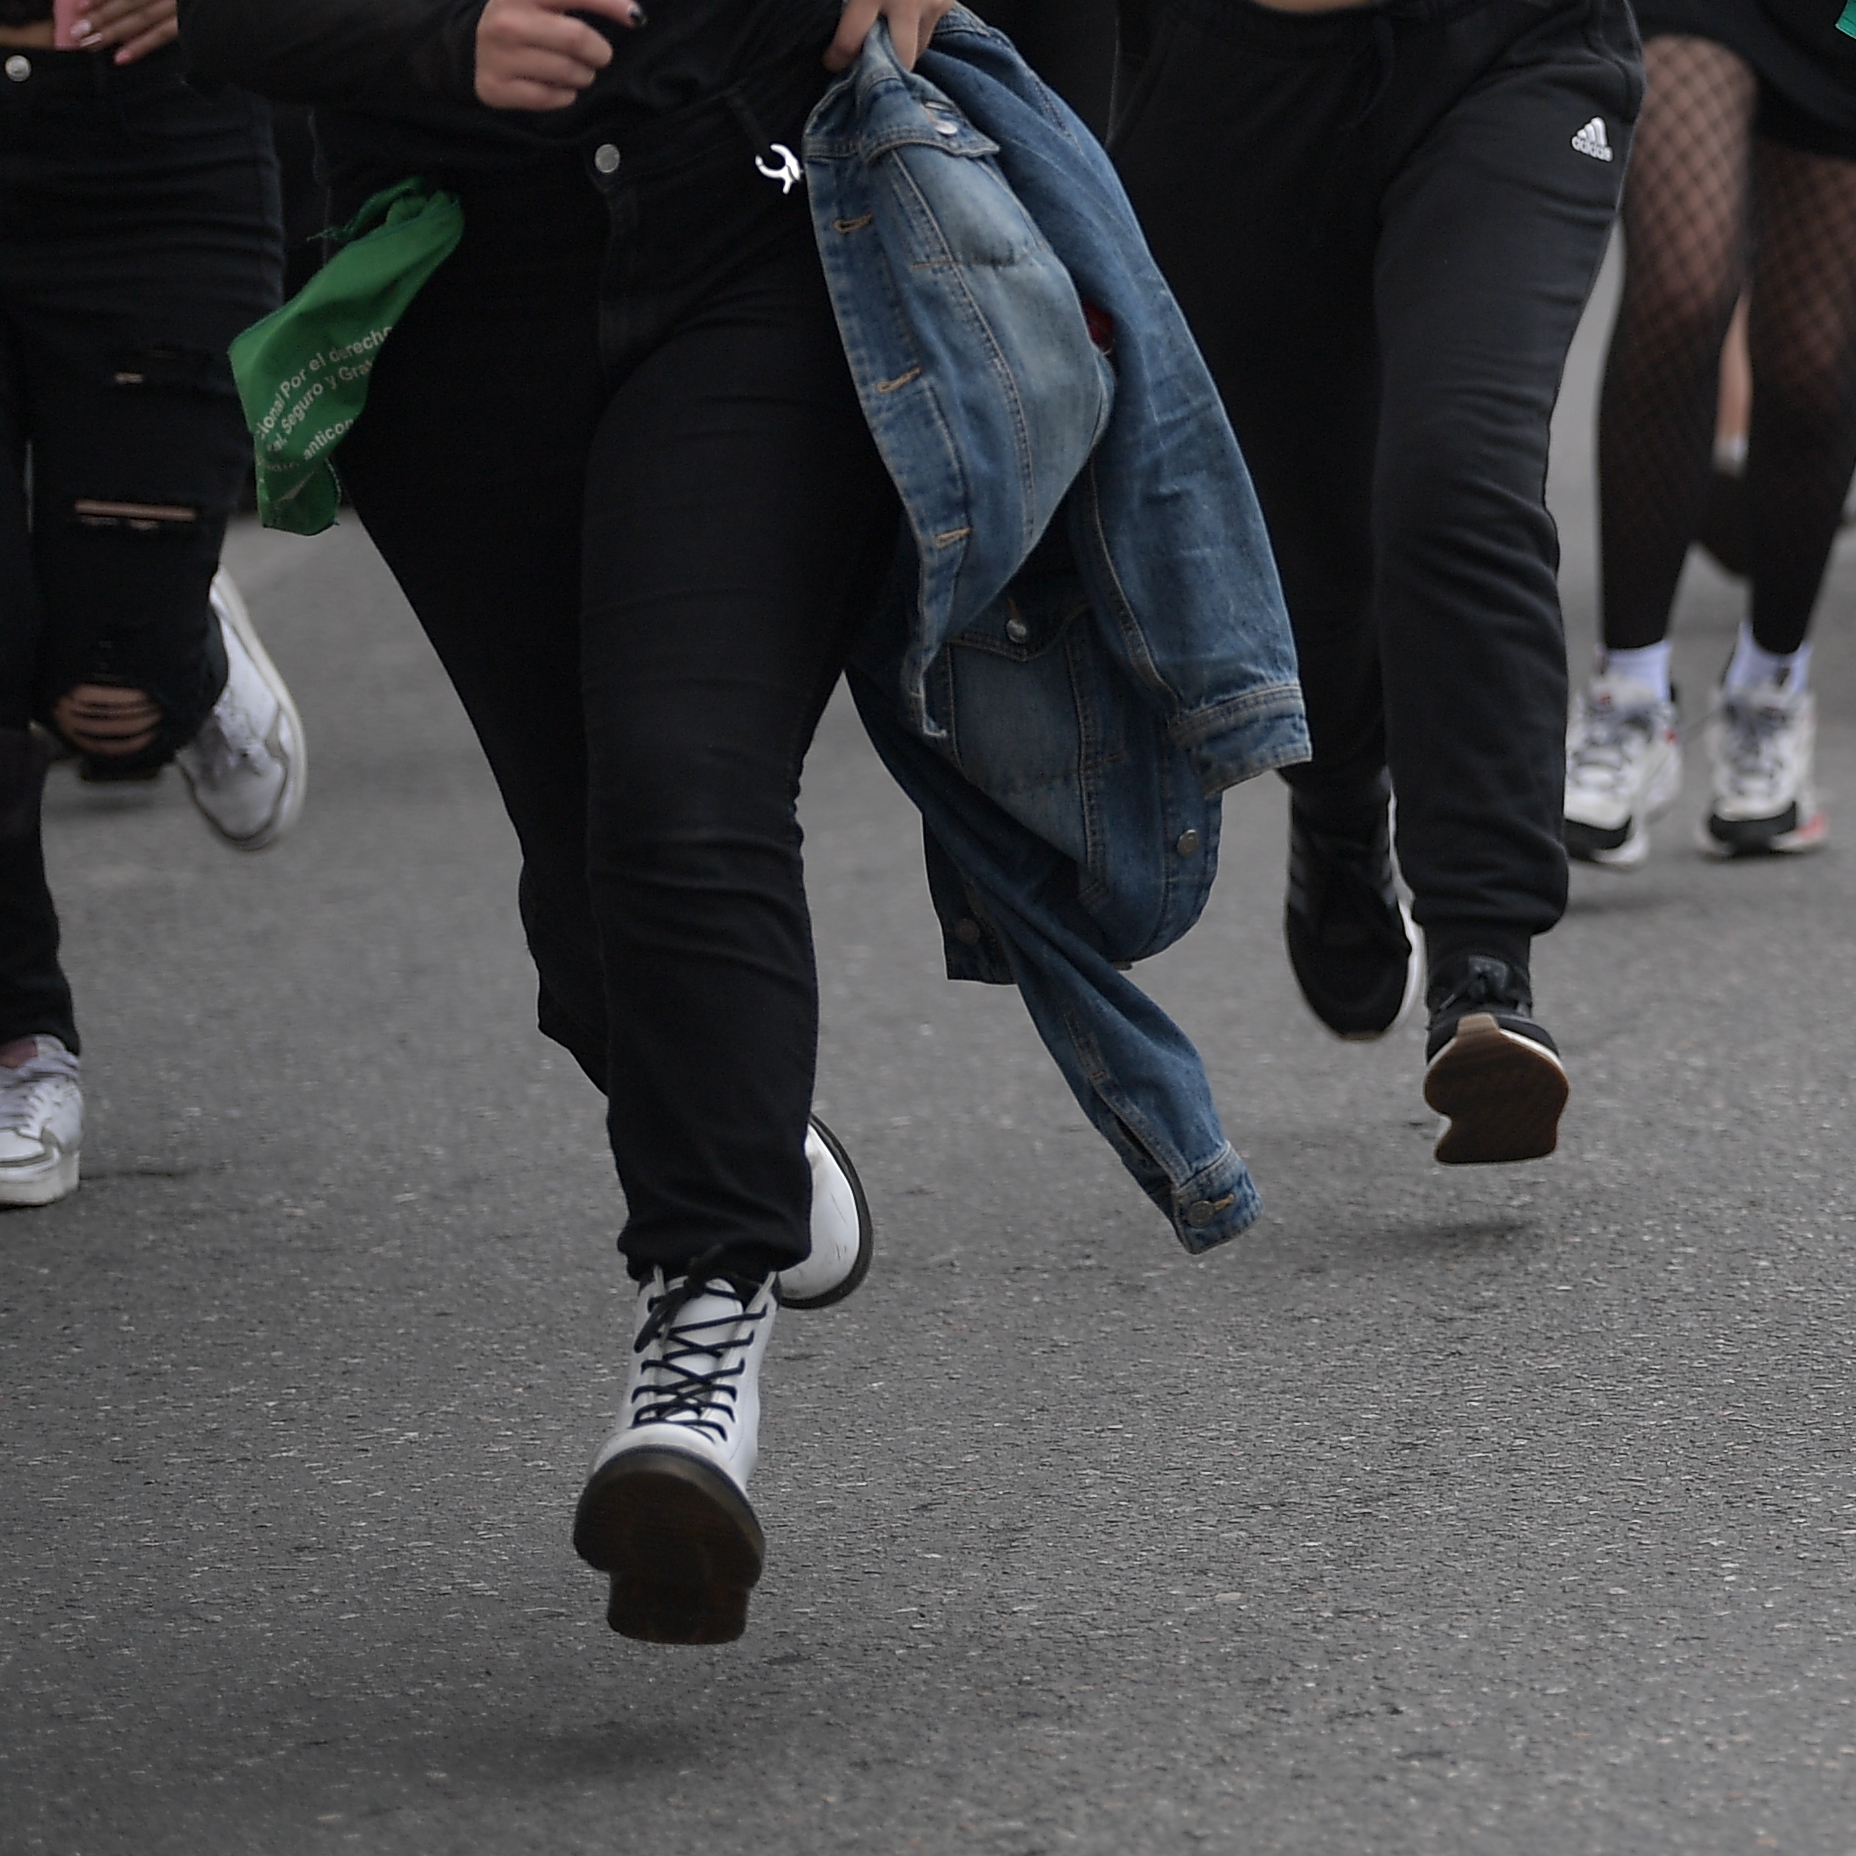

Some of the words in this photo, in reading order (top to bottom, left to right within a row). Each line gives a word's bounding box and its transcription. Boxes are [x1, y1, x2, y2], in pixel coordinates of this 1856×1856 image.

[1571, 135, 1614, 162] adidas
[280, 369, 307, 399] Por
[309, 352, 327, 372] el
[281, 383, 323, 434] Seguro
[325, 374, 337, 390] y
